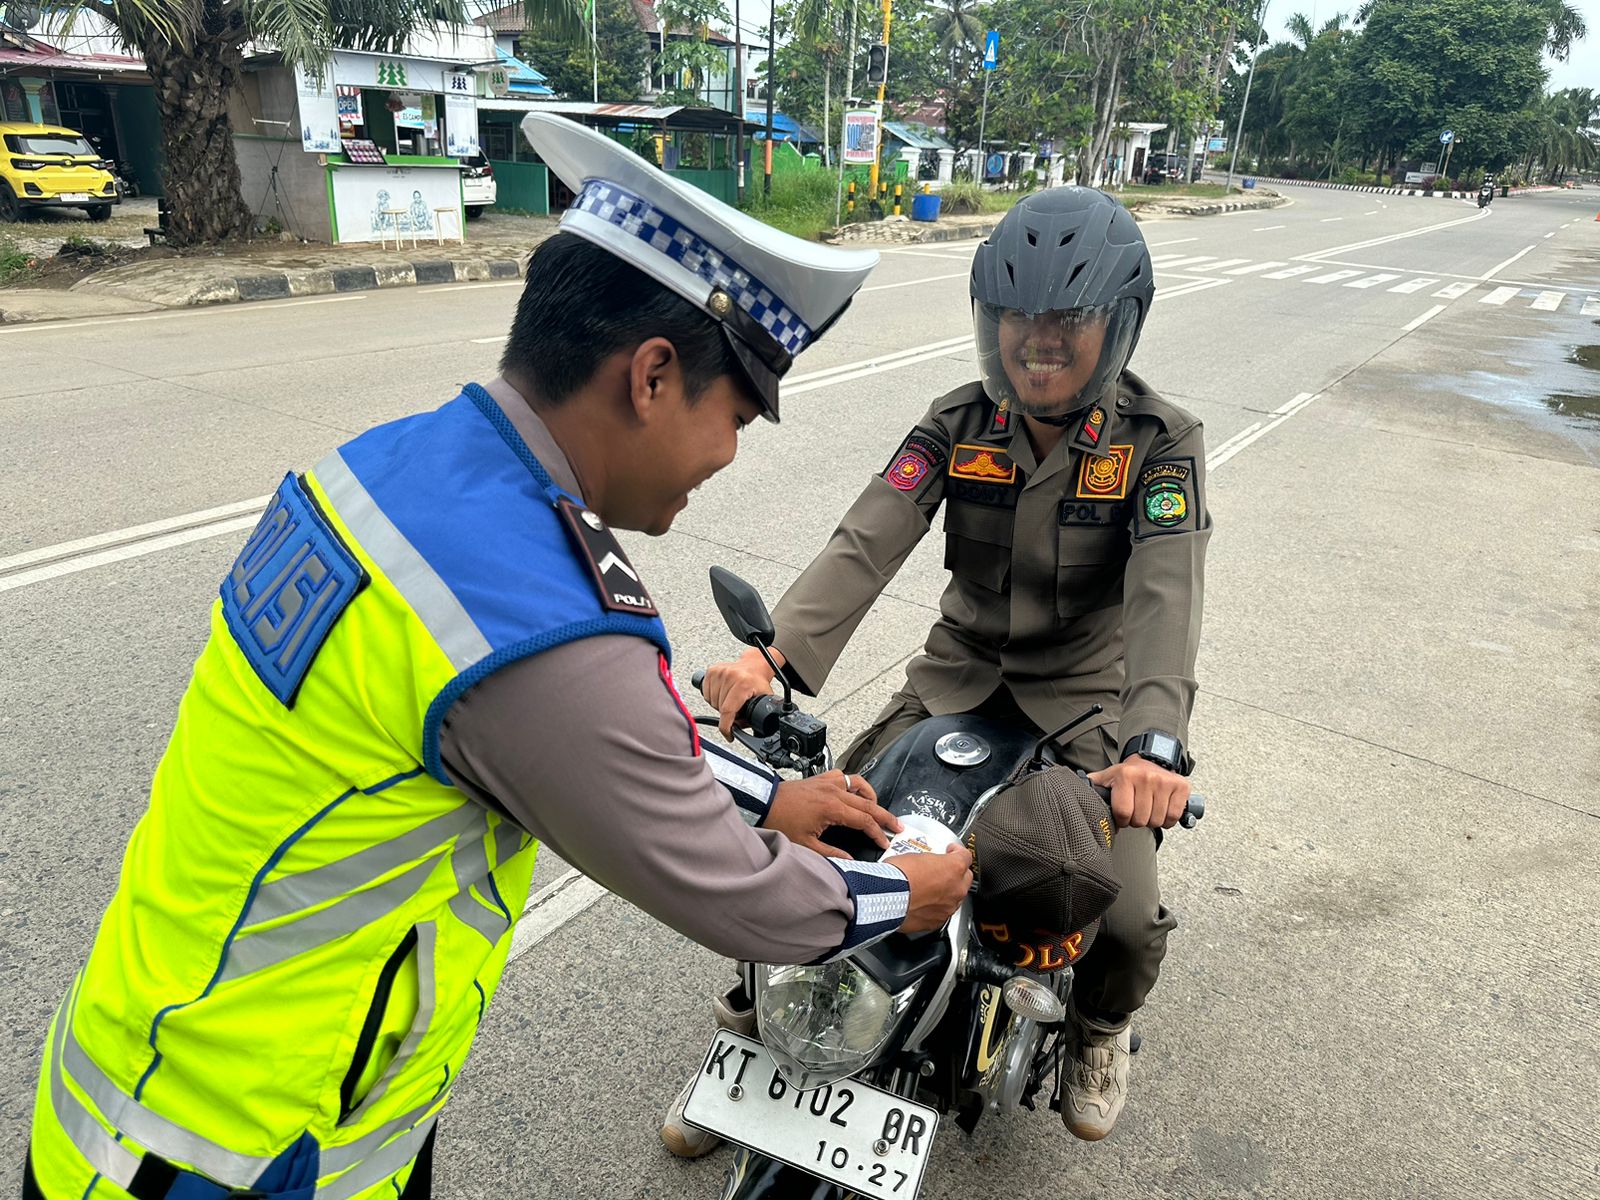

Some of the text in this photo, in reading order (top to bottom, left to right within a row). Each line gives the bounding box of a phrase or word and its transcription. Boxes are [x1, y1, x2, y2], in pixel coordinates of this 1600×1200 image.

[338, 100, 357, 111] OPEN
[706, 1040, 757, 1084] KT
[768, 1064, 855, 1128] 6102
